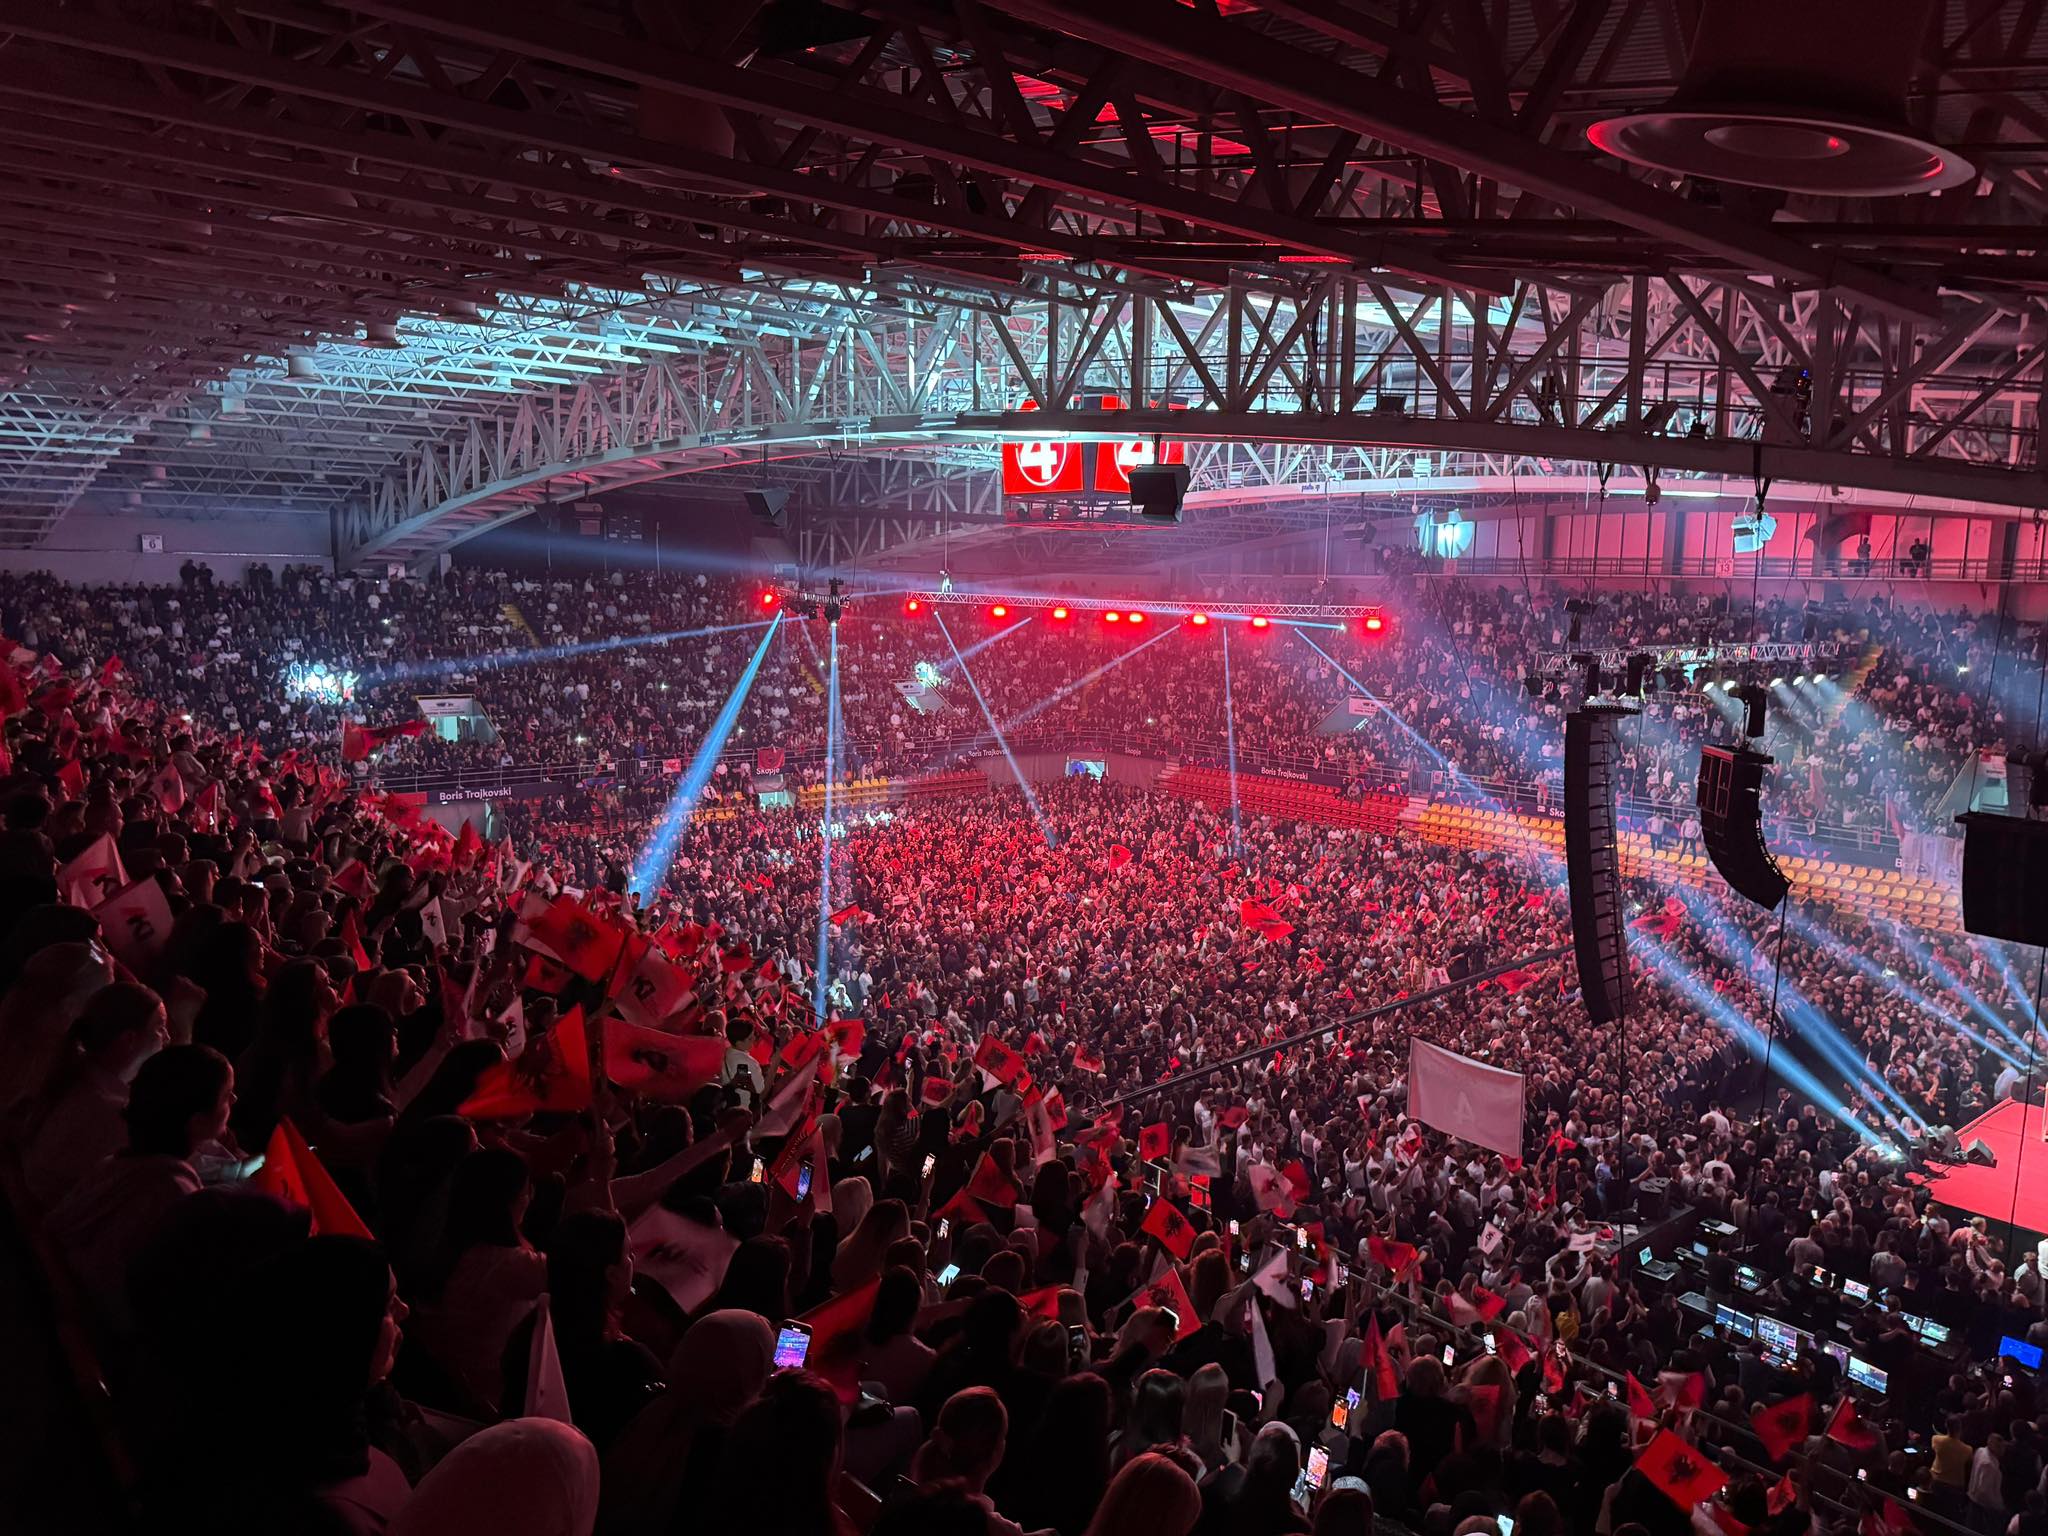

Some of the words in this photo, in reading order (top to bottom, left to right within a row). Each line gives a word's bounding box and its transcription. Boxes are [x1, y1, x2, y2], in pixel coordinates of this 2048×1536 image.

[1020, 441, 1058, 480] 4
[1720, 563, 1730, 572] 13
[982, 748, 1010, 757] Trajkovsi
[1261, 766, 1276, 776] Boris
[1277, 767, 1308, 780] Trajkovski
[440, 791, 463, 801] Boris
[465, 787, 512, 800] Trajkovski
[1549, 807, 1566, 818] Sko
